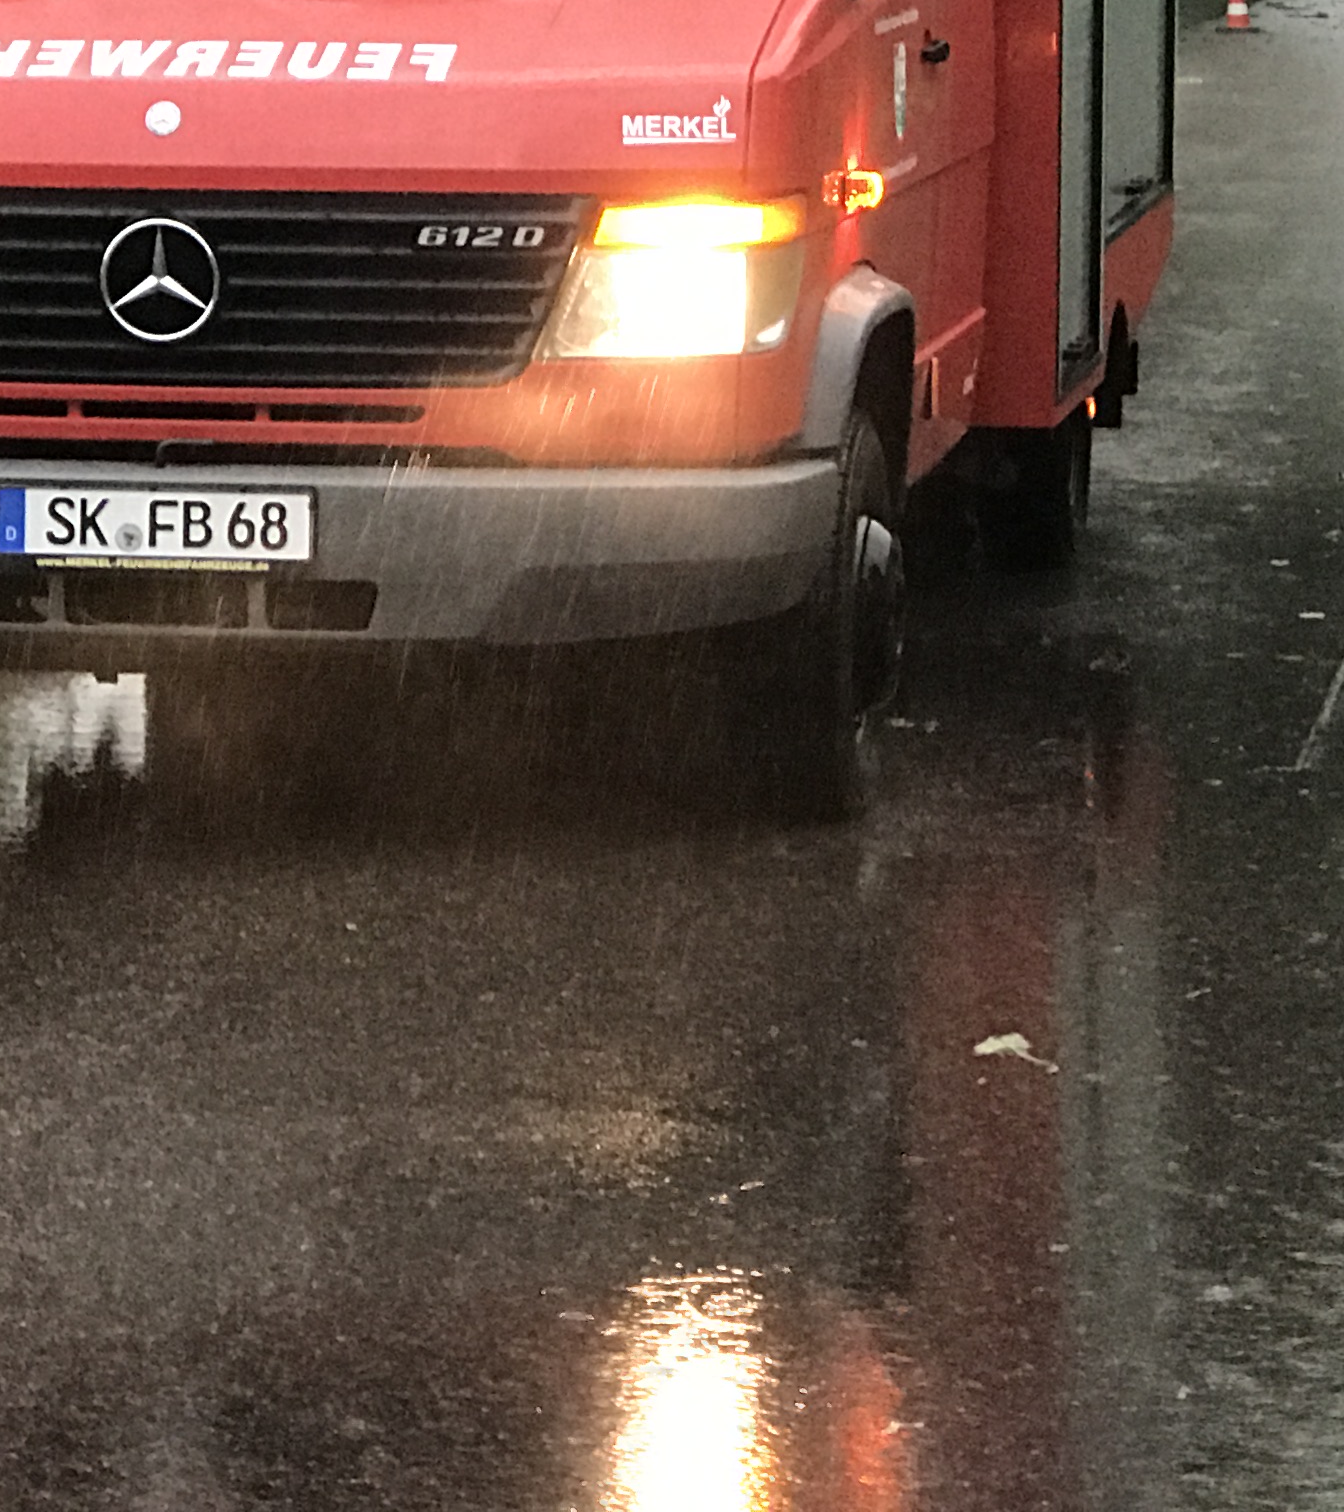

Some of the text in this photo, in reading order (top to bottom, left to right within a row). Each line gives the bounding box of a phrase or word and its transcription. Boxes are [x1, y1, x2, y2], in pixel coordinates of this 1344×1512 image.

[622, 115, 736, 138] MERKEL
[417, 226, 545, 247] 612 D
[6, 527, 17, 541] D
[46, 497, 288, 550] SK FB 68
